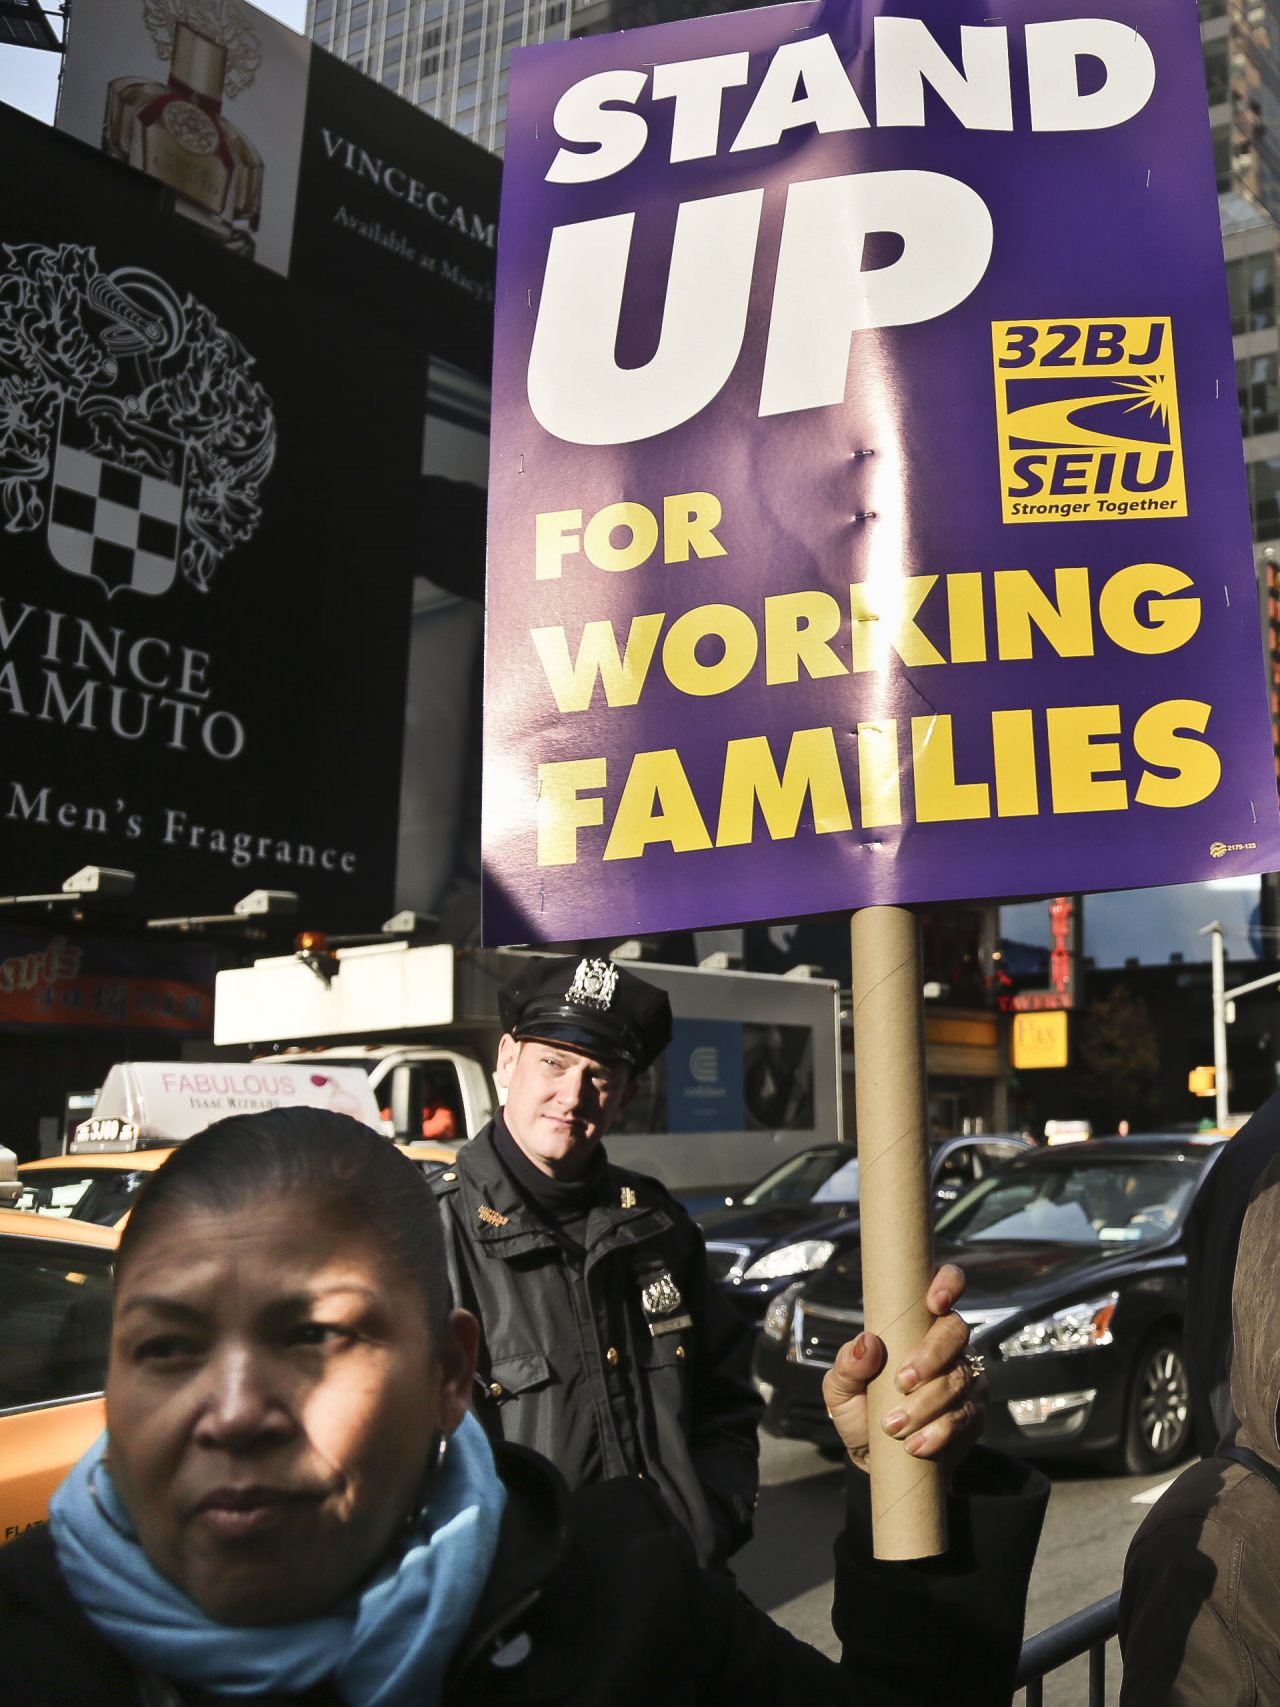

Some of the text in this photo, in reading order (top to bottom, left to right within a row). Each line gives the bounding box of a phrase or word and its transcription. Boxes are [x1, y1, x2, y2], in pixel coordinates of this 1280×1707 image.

[544, 16, 1156, 184] STAND
[527, 169, 993, 445] UP
[999, 323, 1165, 369] 32BJ
[1008, 450, 1174, 497] SEIU
[1011, 498, 1177, 517] Stronger Together
[535, 491, 729, 580] FOR
[0, 598, 211, 698] VINCE
[530, 563, 1201, 713] WORKING
[6, 781, 358, 875] Men's Fragrance
[537, 699, 1222, 868] FAMILIES
[162, 1072, 296, 1096] FABULOUS
